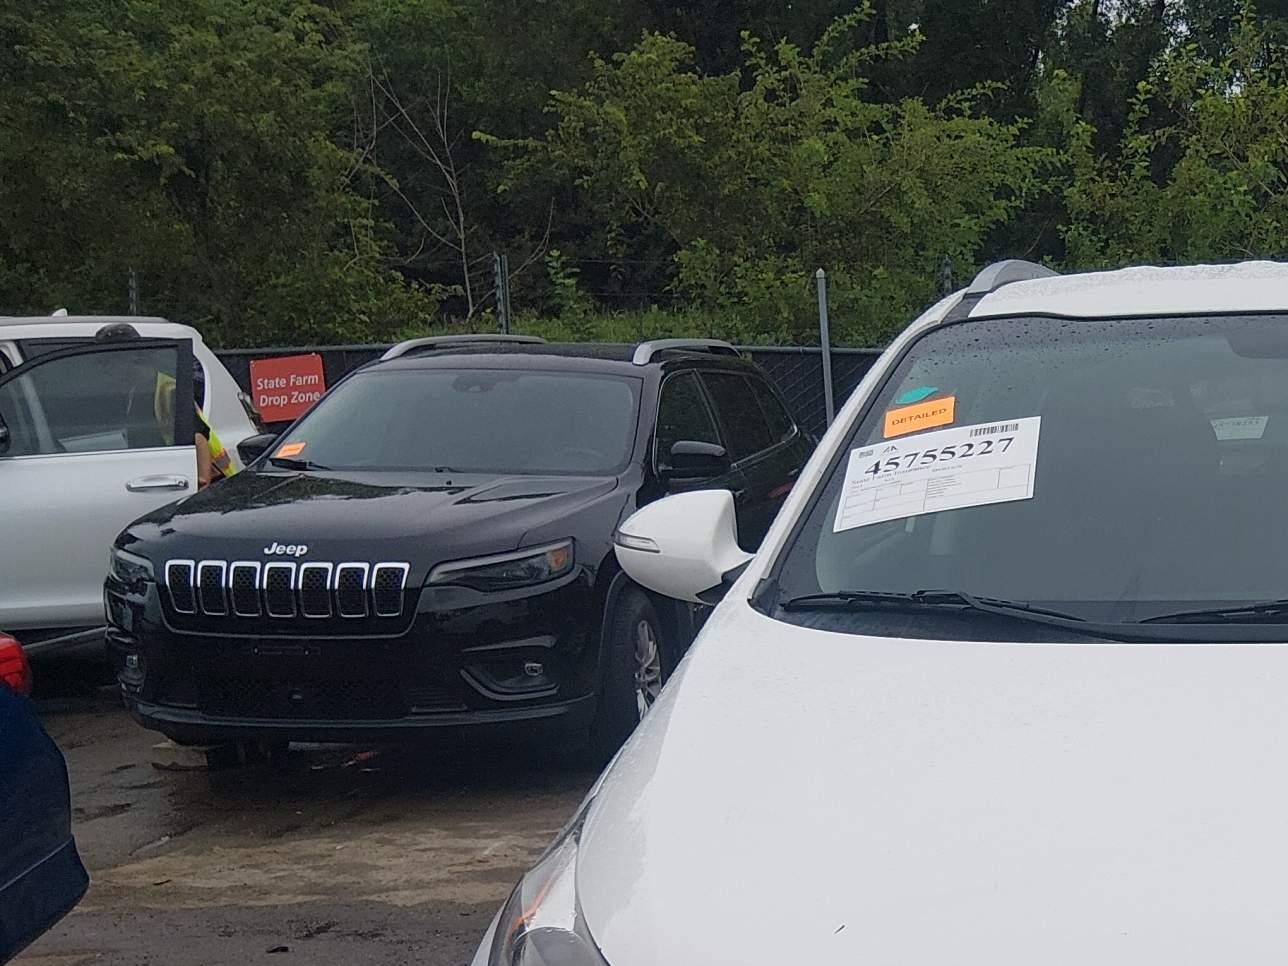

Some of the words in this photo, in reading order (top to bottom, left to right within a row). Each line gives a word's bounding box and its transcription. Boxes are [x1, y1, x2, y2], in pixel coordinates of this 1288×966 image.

[256, 378, 287, 390] State
[289, 374, 319, 386] Farm
[260, 395, 288, 407] Drop
[291, 391, 321, 403] Zone
[891, 408, 948, 425] DETAILED
[864, 436, 1015, 475] 45755227
[263, 542, 308, 557] Jeep
